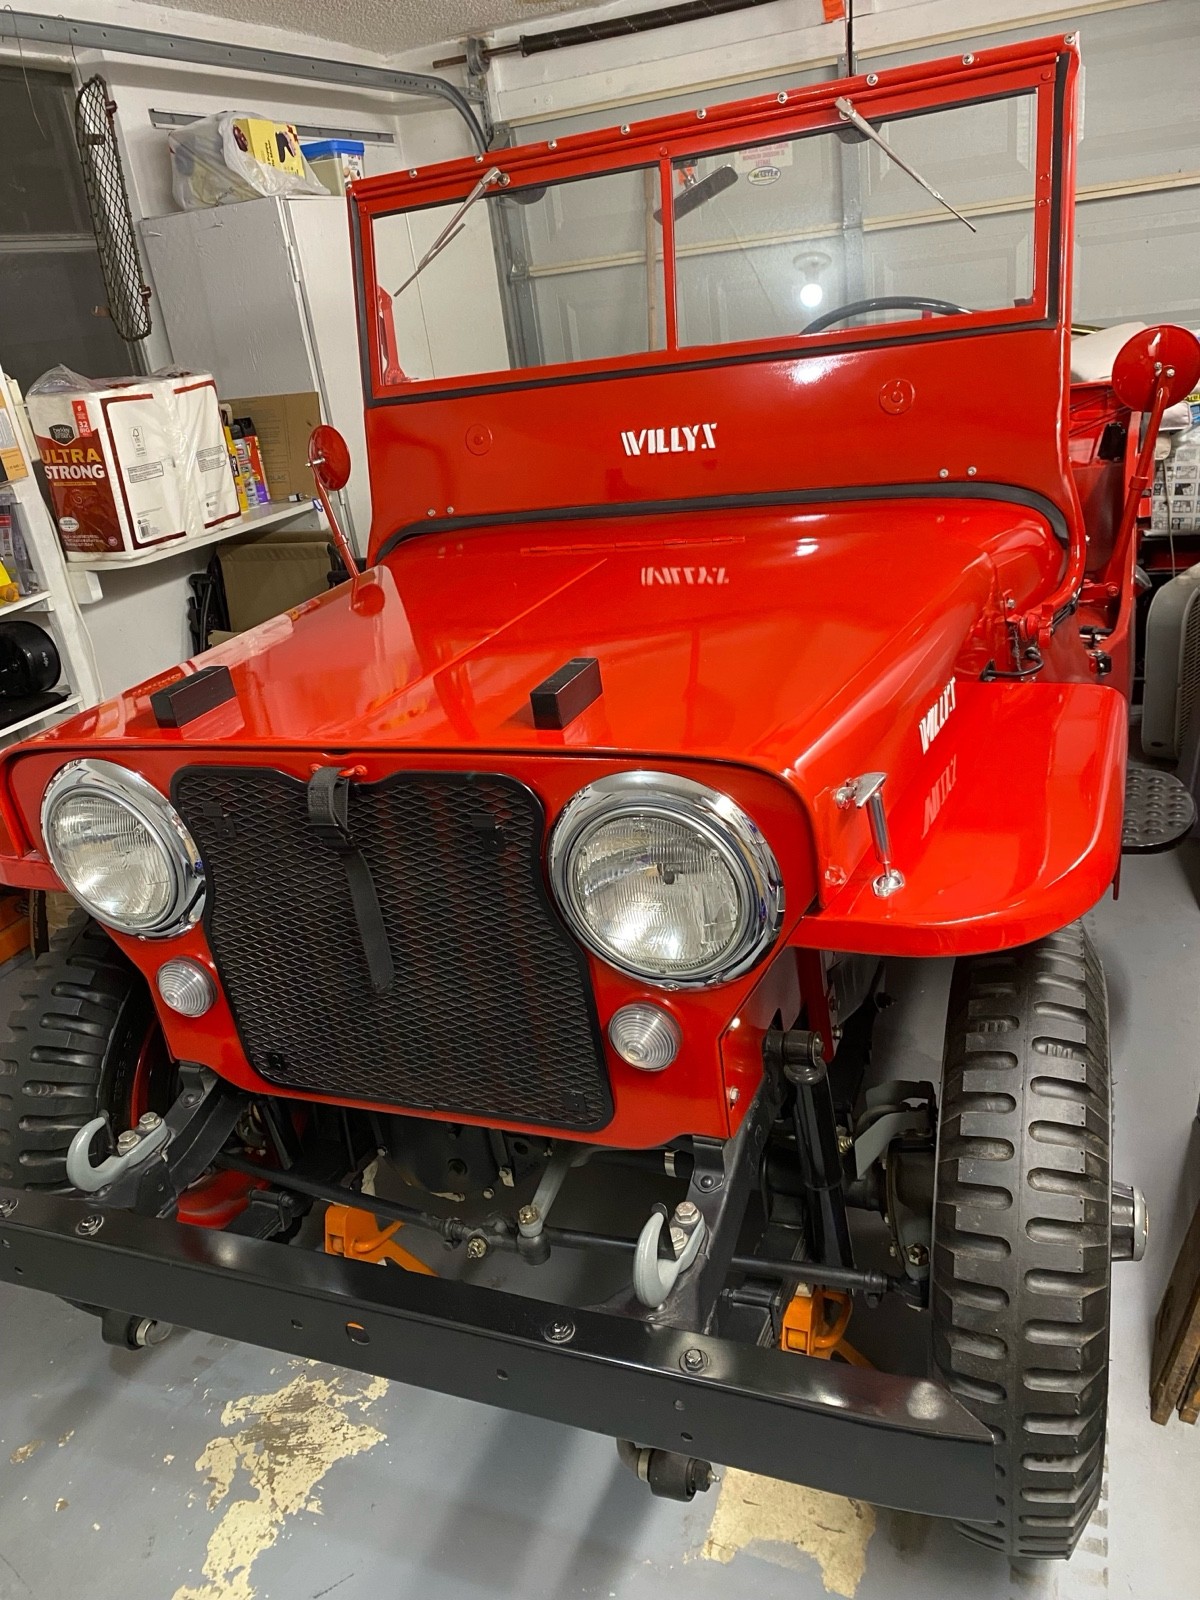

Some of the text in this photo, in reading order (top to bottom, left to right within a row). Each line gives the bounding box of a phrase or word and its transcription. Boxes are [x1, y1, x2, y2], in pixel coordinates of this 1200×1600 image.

[78, 420, 89, 428] 32
[621, 423, 718, 456] WILLYS
[41, 448, 101, 464] ULTRA
[44, 464, 105, 479] STRONG
